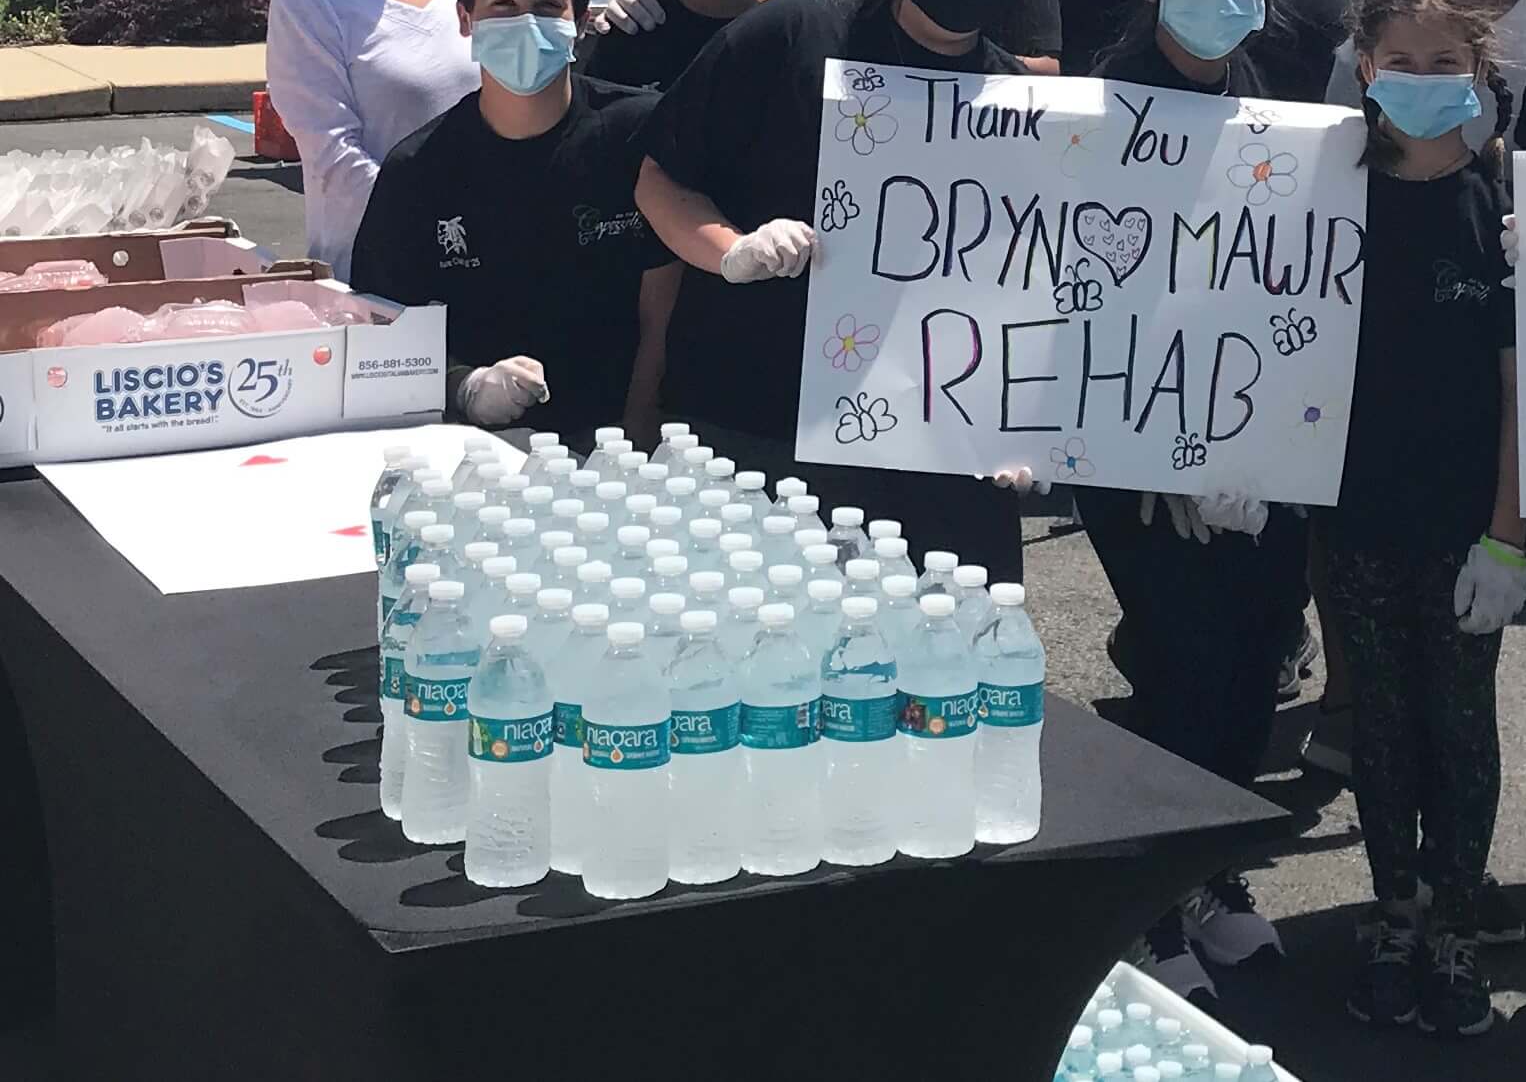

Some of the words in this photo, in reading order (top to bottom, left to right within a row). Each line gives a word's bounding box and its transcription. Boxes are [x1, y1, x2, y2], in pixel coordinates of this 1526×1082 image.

[905, 75, 1047, 143] Thank
[1115, 93, 1188, 166] You
[872, 175, 1068, 290] BRYN
[1169, 206, 1366, 305] MAWR
[94, 362, 225, 394] LISCIO'S
[922, 308, 1262, 443] REHAB
[95, 388, 225, 421] BAKERY
[417, 683, 468, 708] niaga
[941, 695, 977, 721] niag
[503, 716, 553, 746] niaga
[586, 725, 658, 755] niagara
